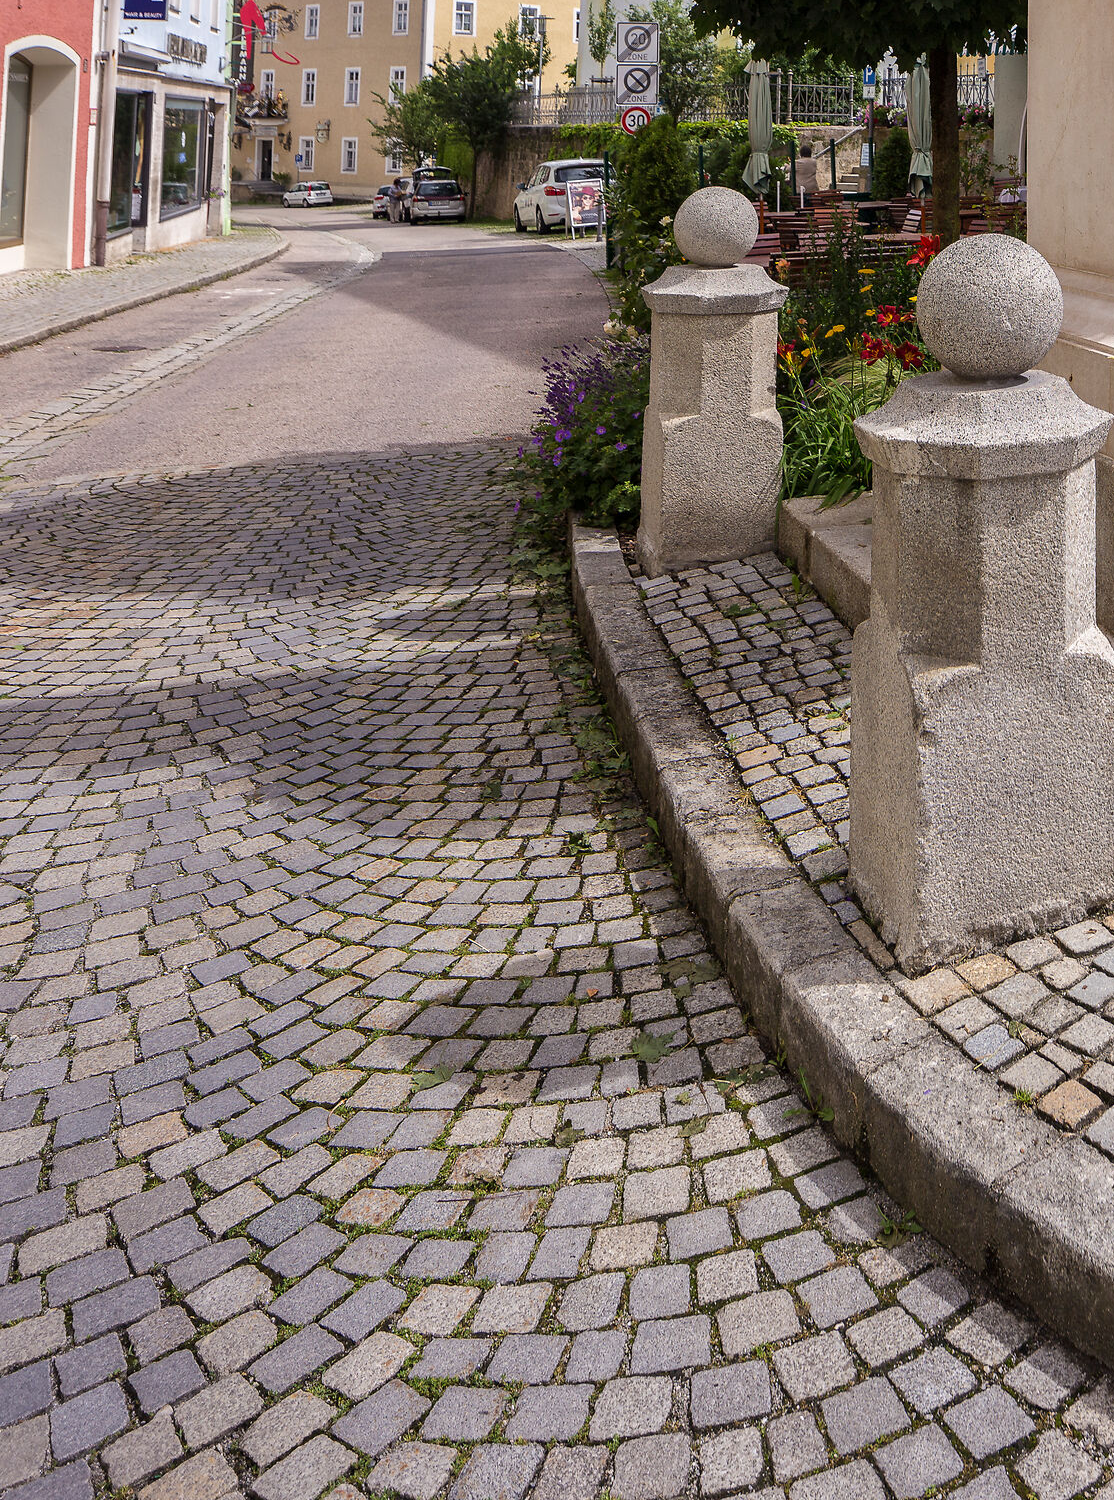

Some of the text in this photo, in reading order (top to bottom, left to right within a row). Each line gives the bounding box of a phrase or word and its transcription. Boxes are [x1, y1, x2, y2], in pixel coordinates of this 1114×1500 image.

[630, 32, 647, 46] 20
[627, 53, 648, 61] ZONE
[626, 95, 648, 103] ZONE
[627, 114, 646, 128] 30
